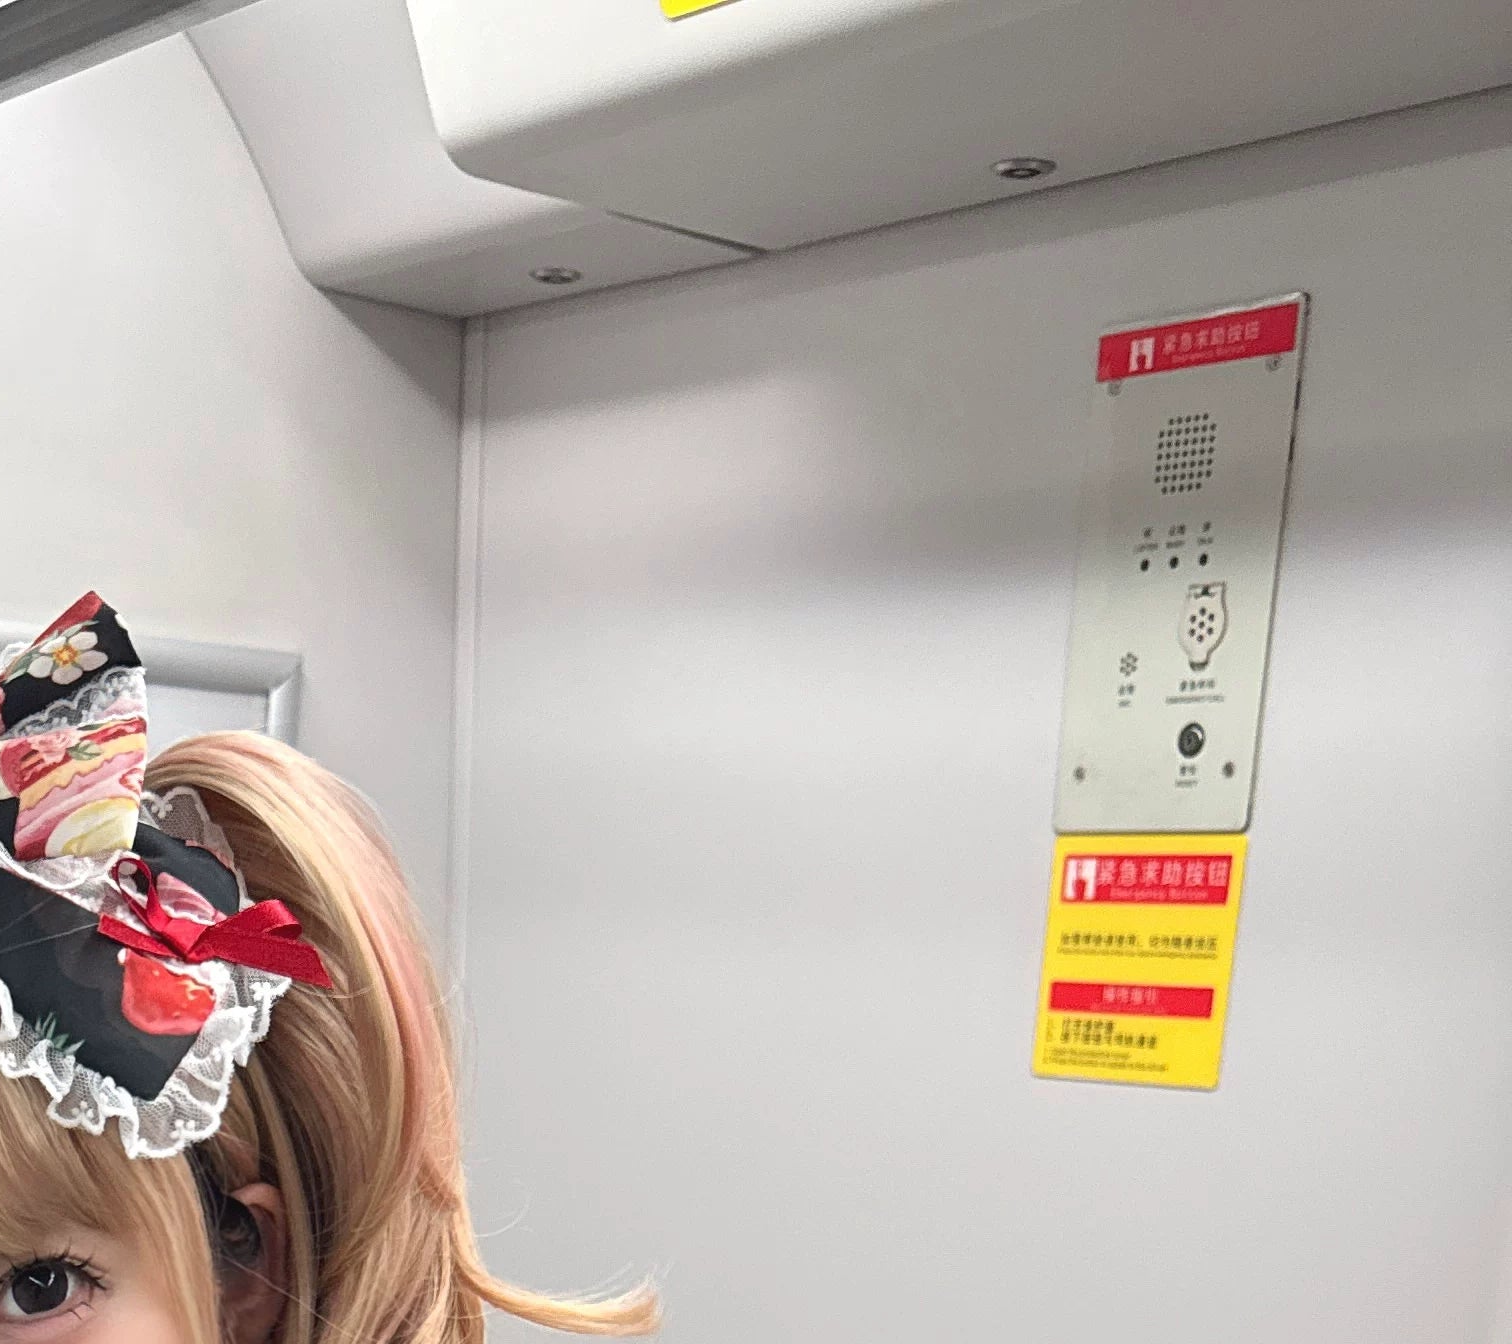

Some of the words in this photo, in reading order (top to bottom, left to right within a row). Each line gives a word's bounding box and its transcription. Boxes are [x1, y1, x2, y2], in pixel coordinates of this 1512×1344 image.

[1096, 859, 1228, 887] 紧急求助按钮
